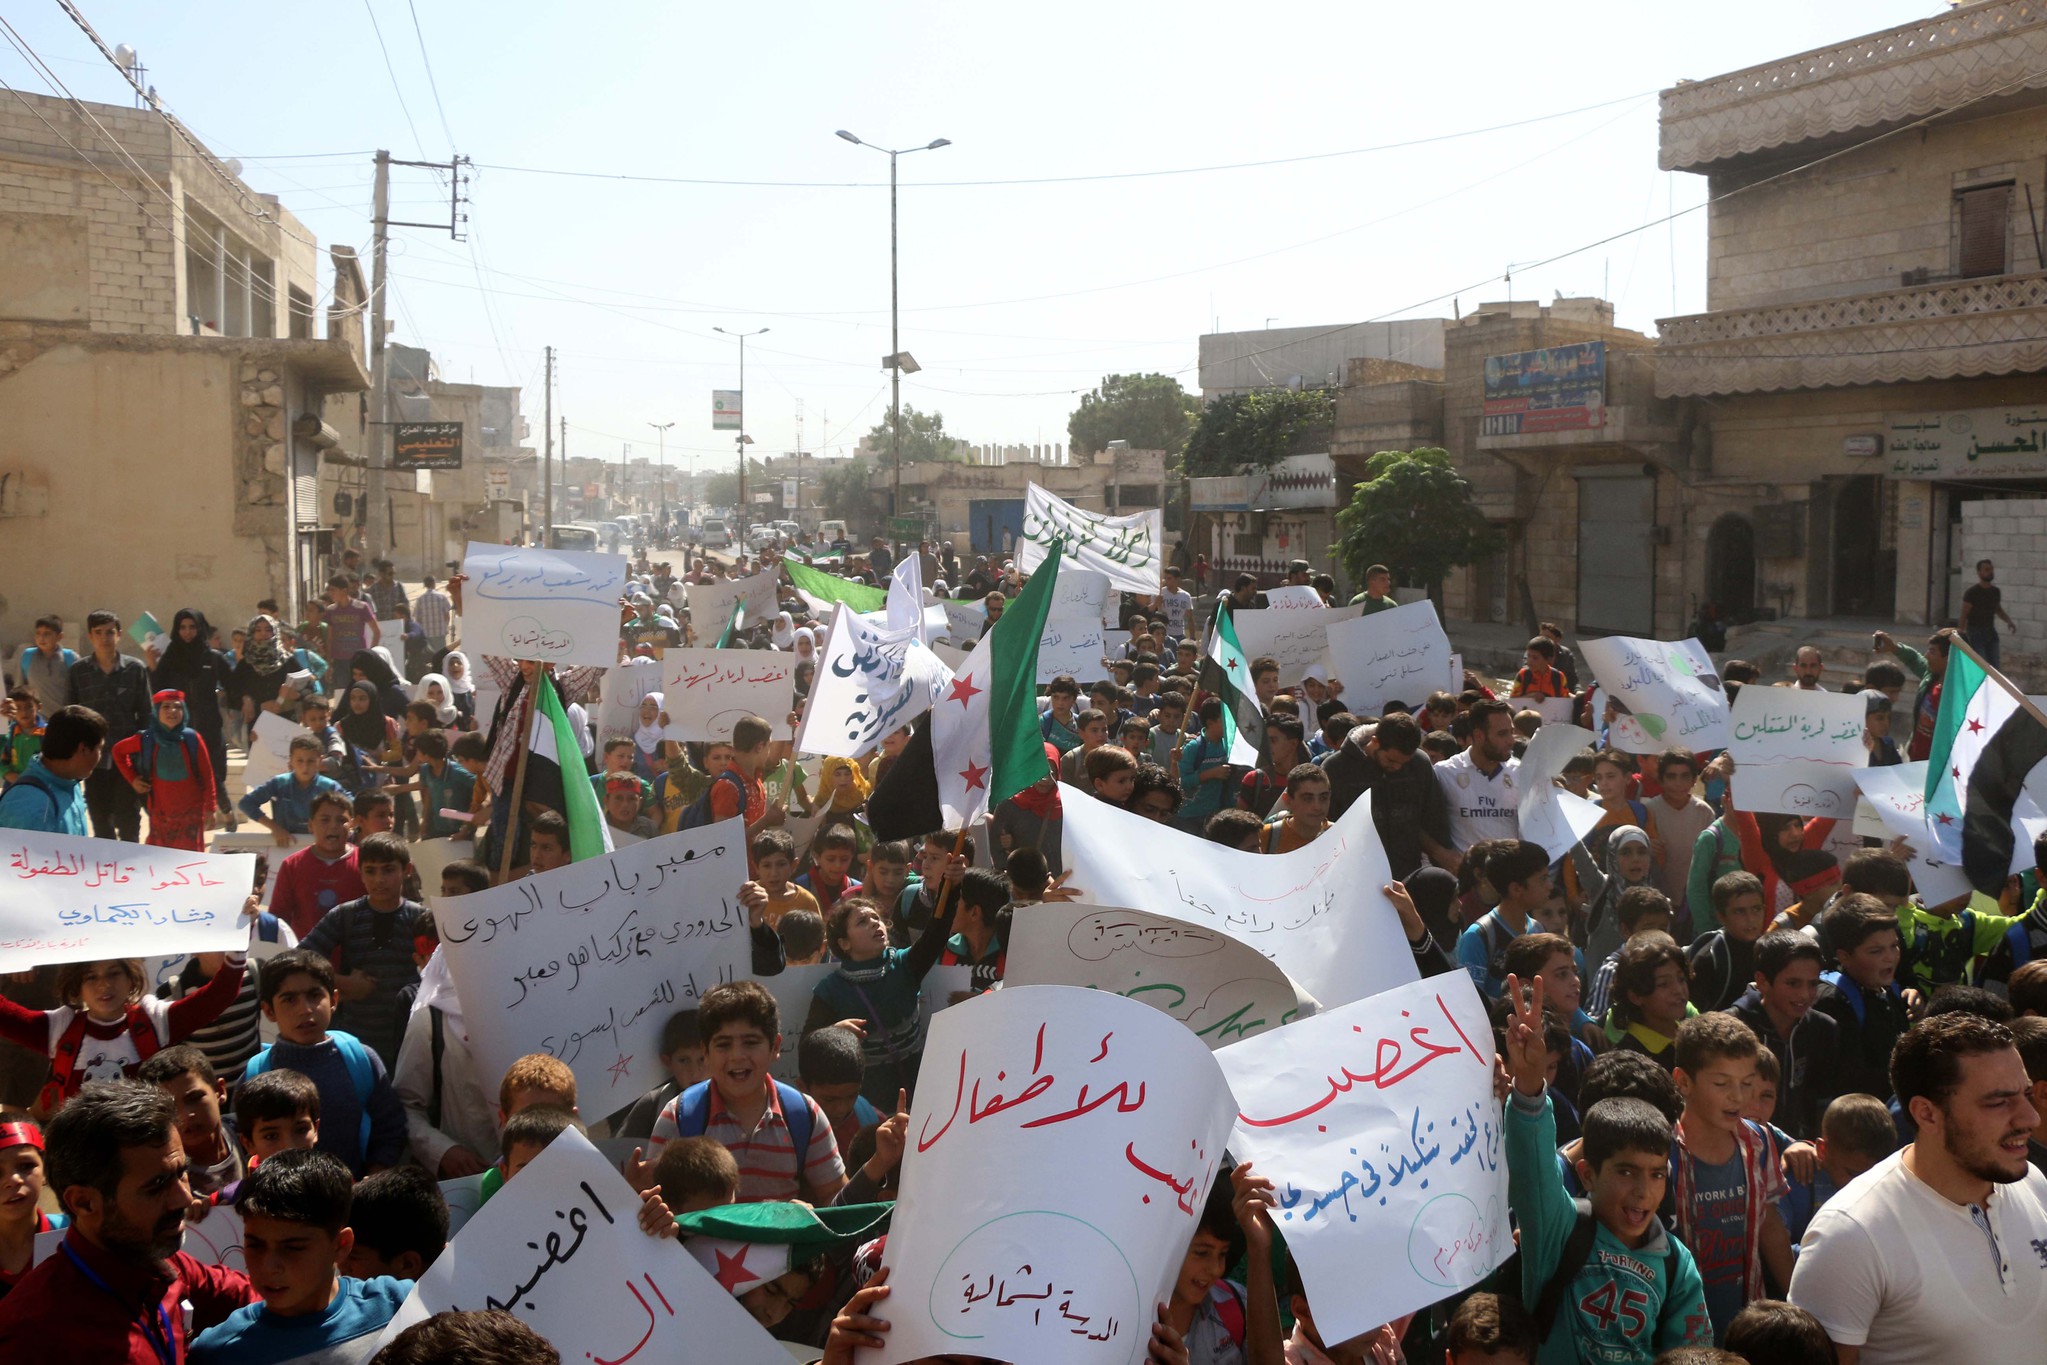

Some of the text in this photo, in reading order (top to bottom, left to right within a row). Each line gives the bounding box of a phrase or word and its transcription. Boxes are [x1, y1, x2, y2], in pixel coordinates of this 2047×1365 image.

[400, 424, 457, 436] مركز عبد العزيز
[398, 437, 460, 453] التعليمي
[1967, 428, 2047, 462] المحسن
[543, 573, 591, 592] شعب
[587, 571, 618, 591] نحن
[1180, 600, 1187, 608] IS
[509, 631, 570, 650] المدرسة الشمالية
[1069, 633, 1100, 654] اغضب
[670, 661, 788, 692] اغضب لدماء الشهداء
[1800, 716, 1825, 740] لحرية
[1830, 720, 1861, 744] اغضب
[1460, 807, 1515, 818] Emirates
[1478, 796, 1496, 807] Fly
[10, 846, 225, 891] حاكموا قاتل الطفولة
[442, 845, 726, 943] معبر باب الهوى
[153, 908, 216, 927] بشار
[661, 897, 744, 944] الحدودي
[591, 909, 640, 964] تركيا
[566, 945, 590, 992] هو
[505, 959, 560, 1010] معبر
[1237, 993, 1488, 1132] اغضب
[917, 1021, 1147, 1153] للأطفال
[1125, 1139, 1214, 1217] اغضب
[1697, 1189, 1727, 1202] YORK
[960, 1264, 1053, 1327] الشمالية
[1579, 1278, 1649, 1339] 45
